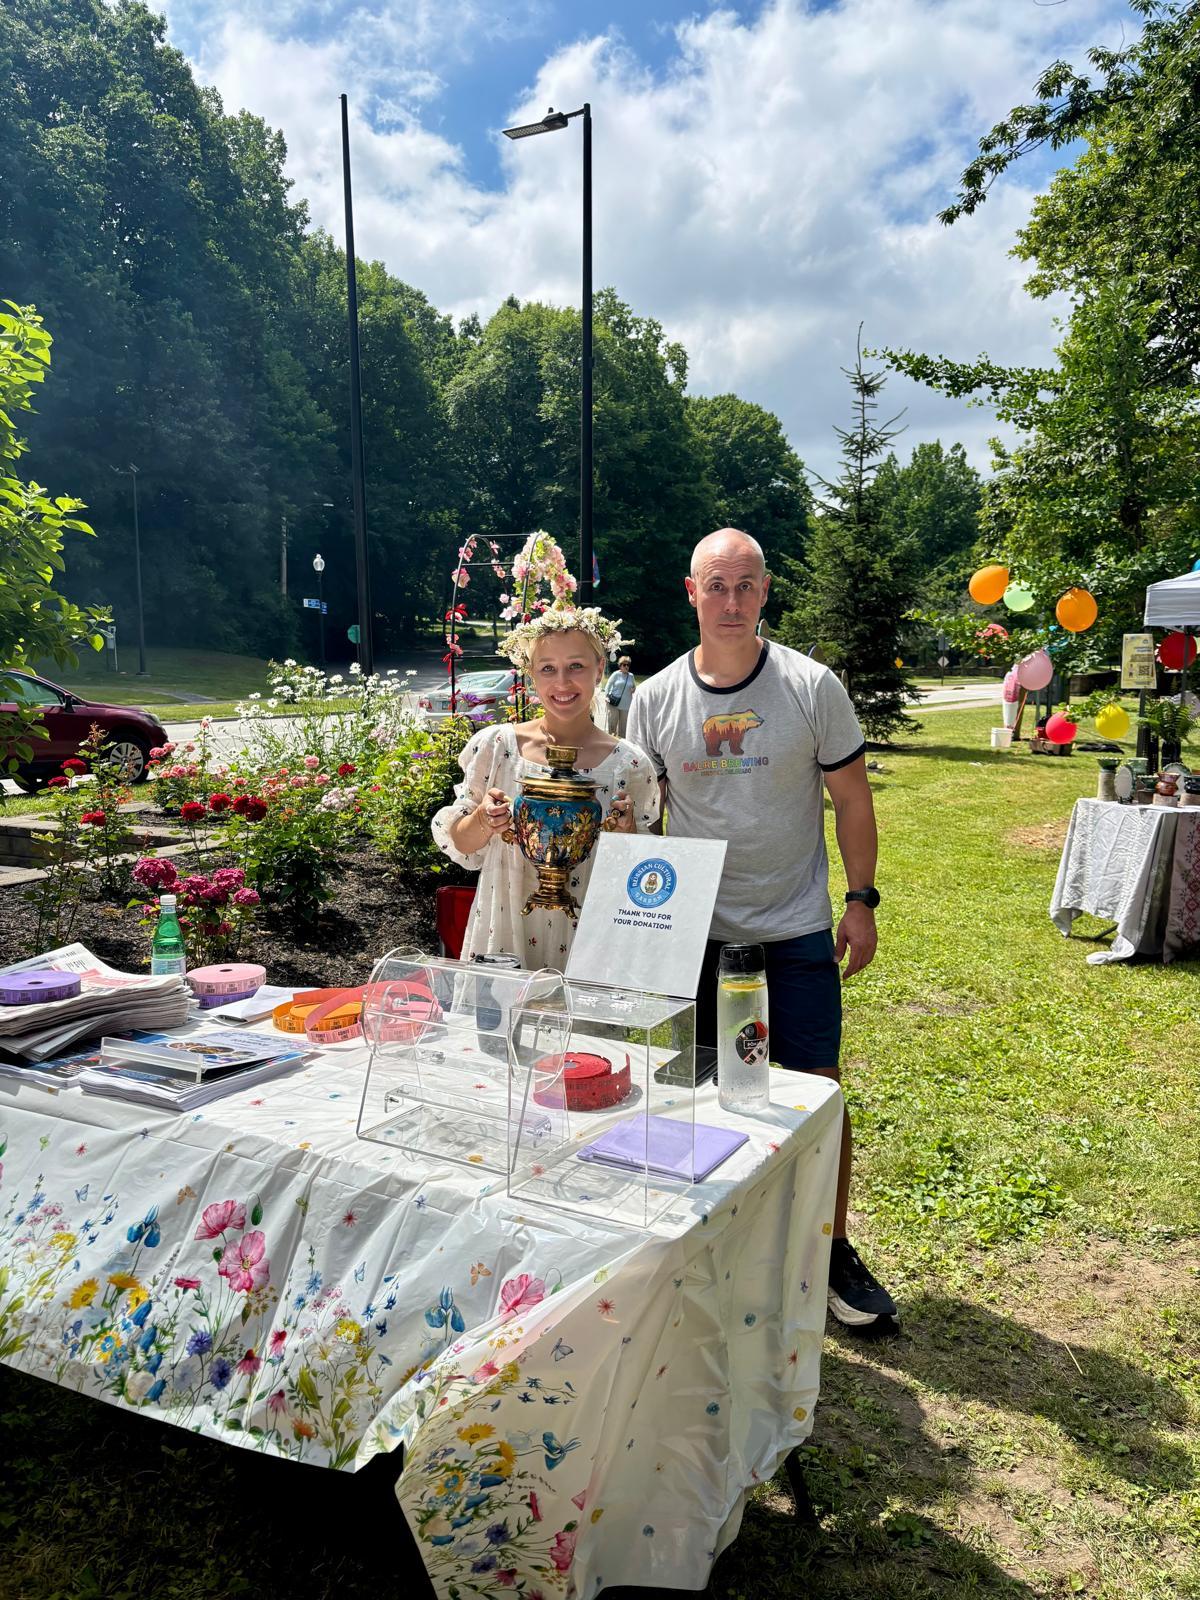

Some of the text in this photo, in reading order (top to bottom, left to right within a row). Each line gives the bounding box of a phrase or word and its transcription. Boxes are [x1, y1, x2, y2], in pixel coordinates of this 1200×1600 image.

[632, 863, 672, 891] RUSSIAN CULTURAL
[618, 908, 672, 921] THANK YOU FOR
[613, 917, 673, 931] YOUR DONATION!
